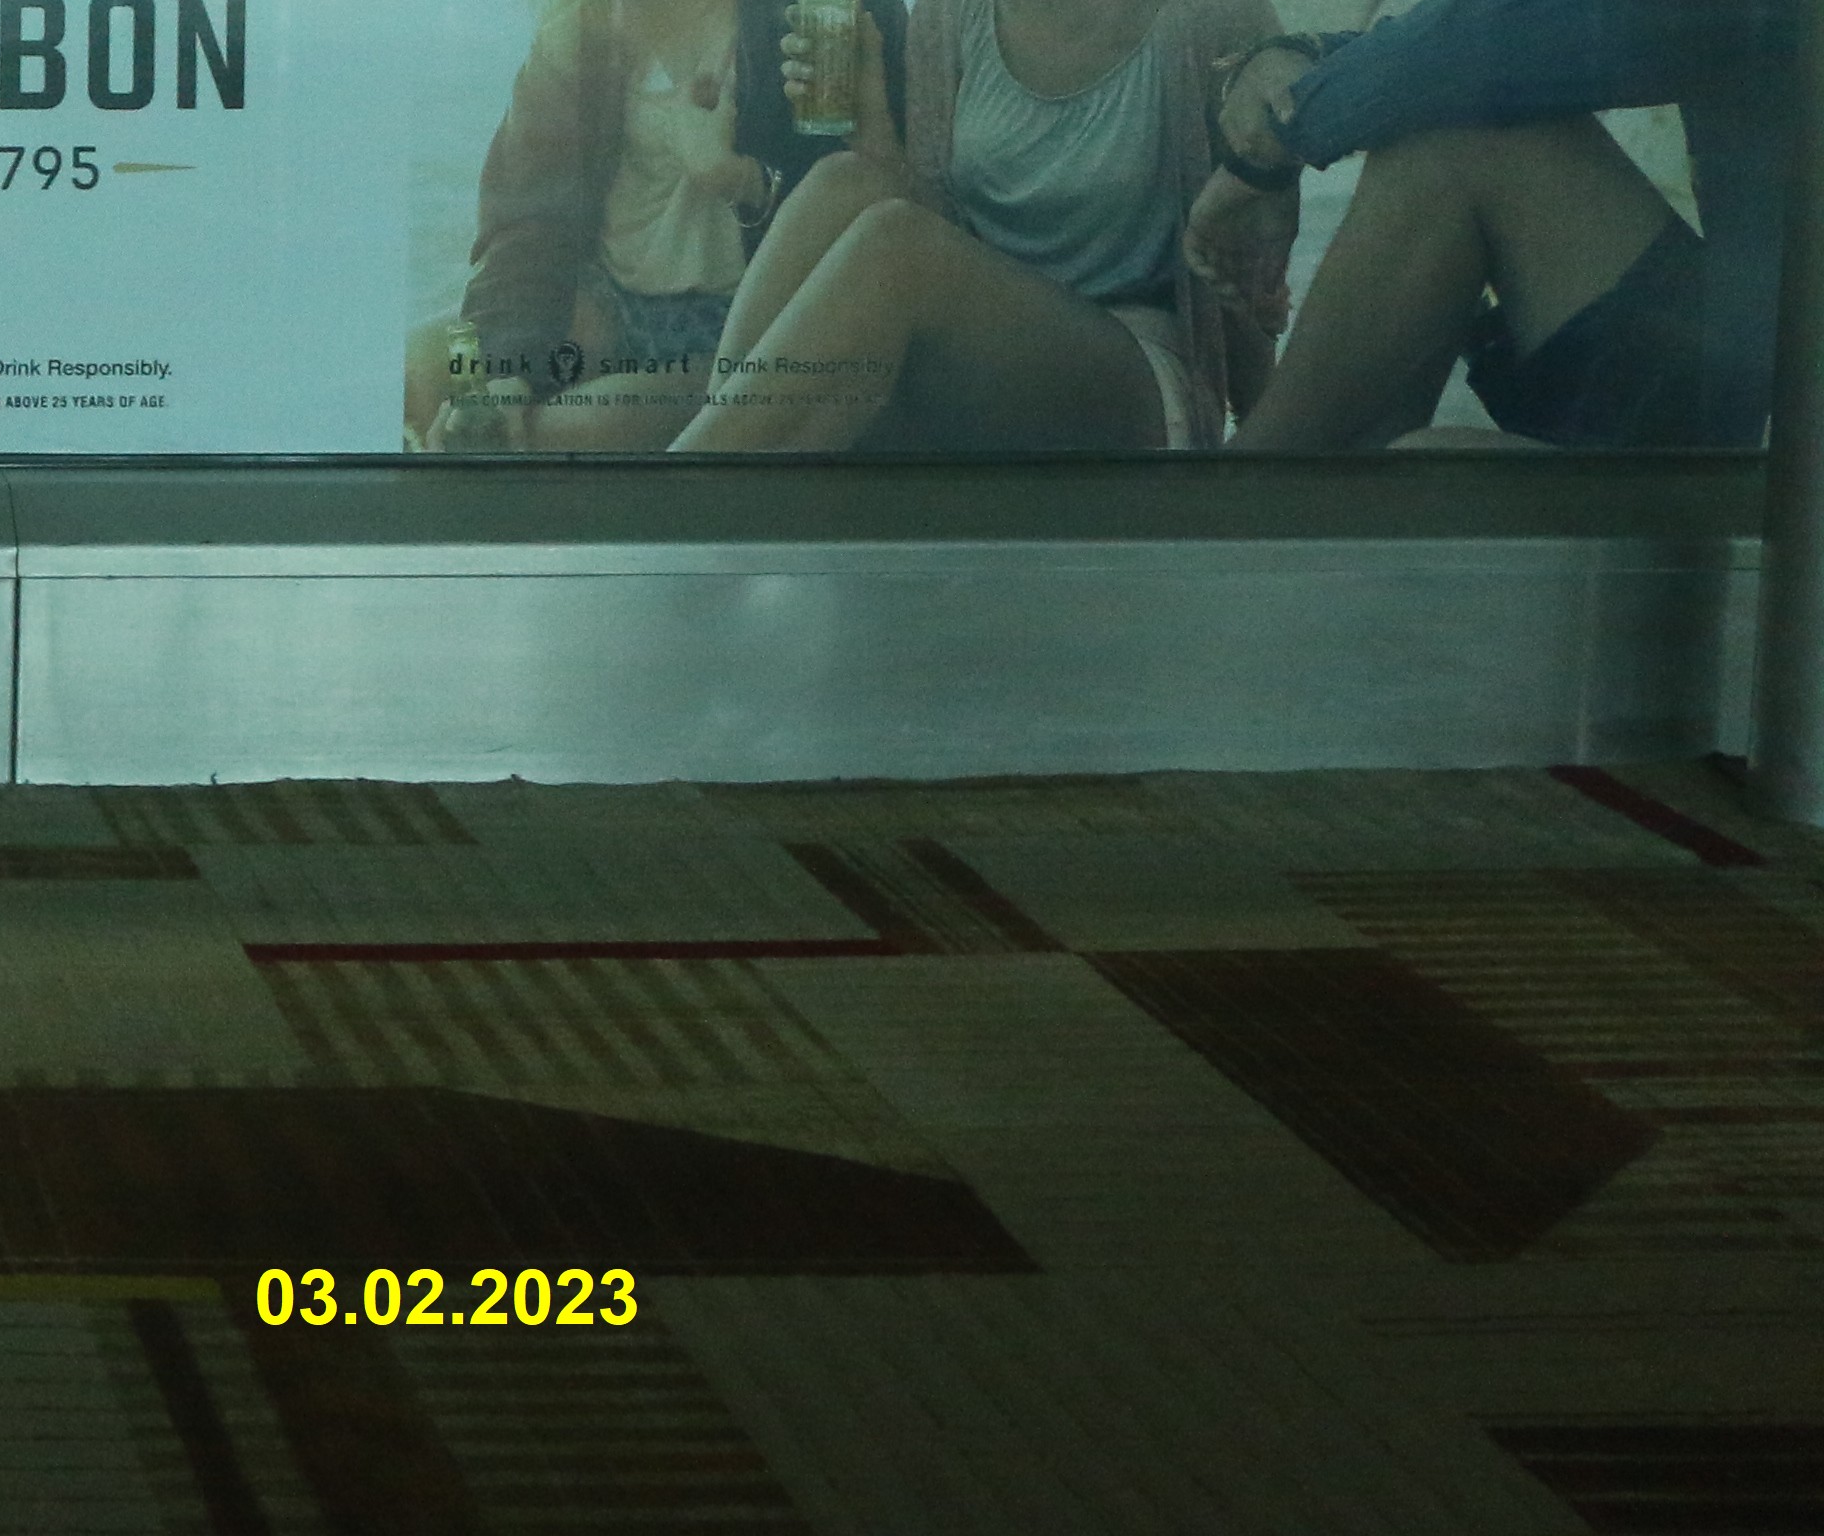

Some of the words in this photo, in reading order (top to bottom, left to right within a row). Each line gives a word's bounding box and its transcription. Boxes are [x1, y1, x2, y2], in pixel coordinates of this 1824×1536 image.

[48, 359, 173, 380] Responsibly.
[448, 353, 532, 375] drink
[716, 357, 768, 375] Drink
[5, 395, 48, 409] ABOVE
[52, 395, 68, 409] 25
[72, 395, 115, 409] YEARS
[119, 395, 136, 409] OF
[597, 394, 611, 407] IS
